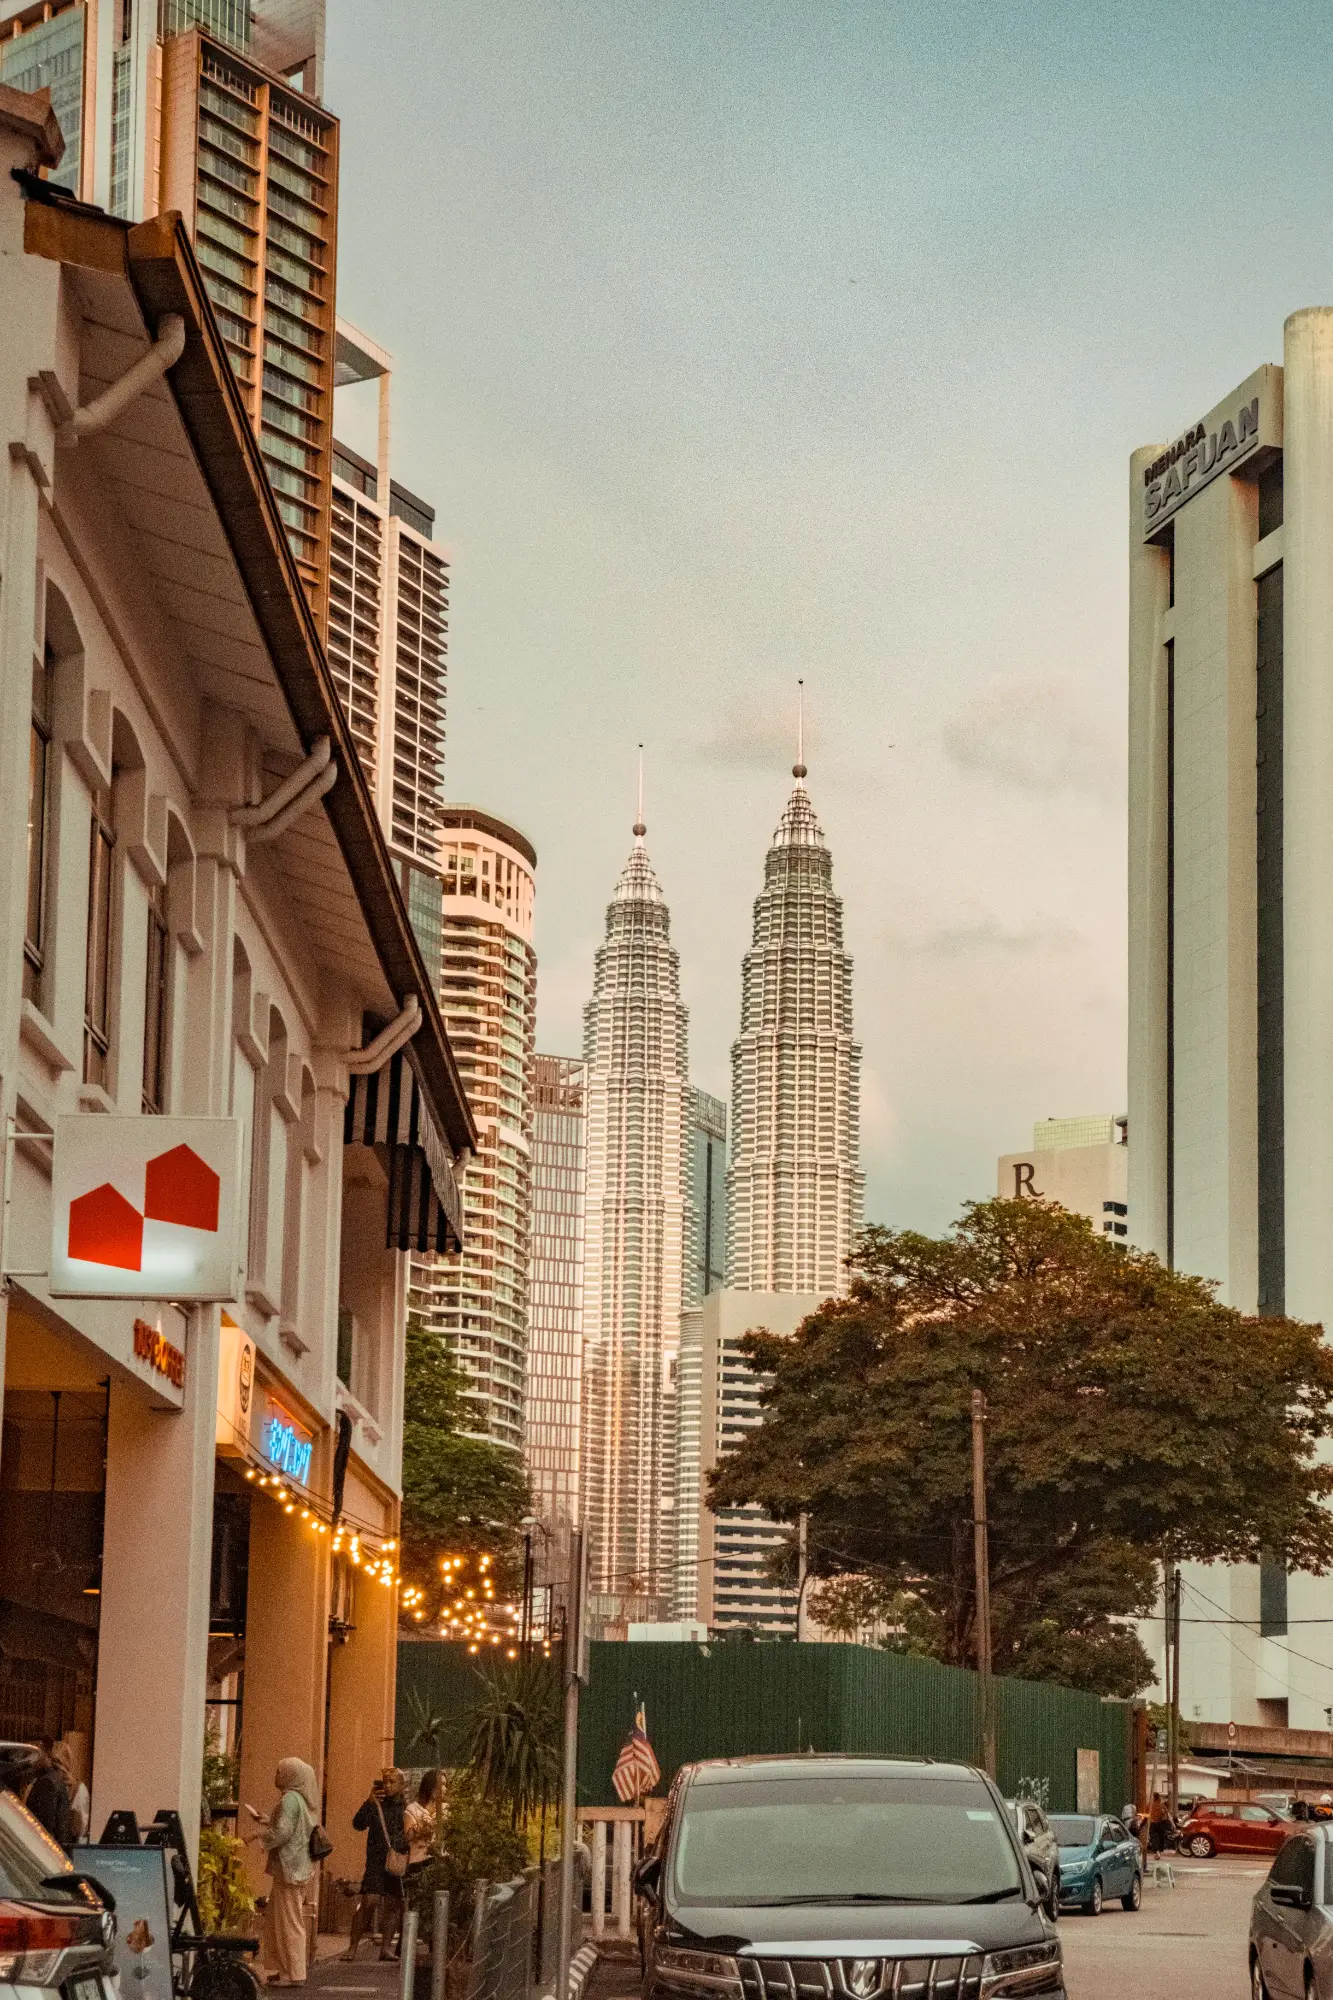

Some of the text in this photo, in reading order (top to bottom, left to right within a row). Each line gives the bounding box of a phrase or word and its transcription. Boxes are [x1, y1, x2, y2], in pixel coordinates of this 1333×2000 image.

[1144, 422, 1206, 487] MENARA
[1144, 397, 1259, 519] SAFUAN
[1012, 1162, 1044, 1199] R
